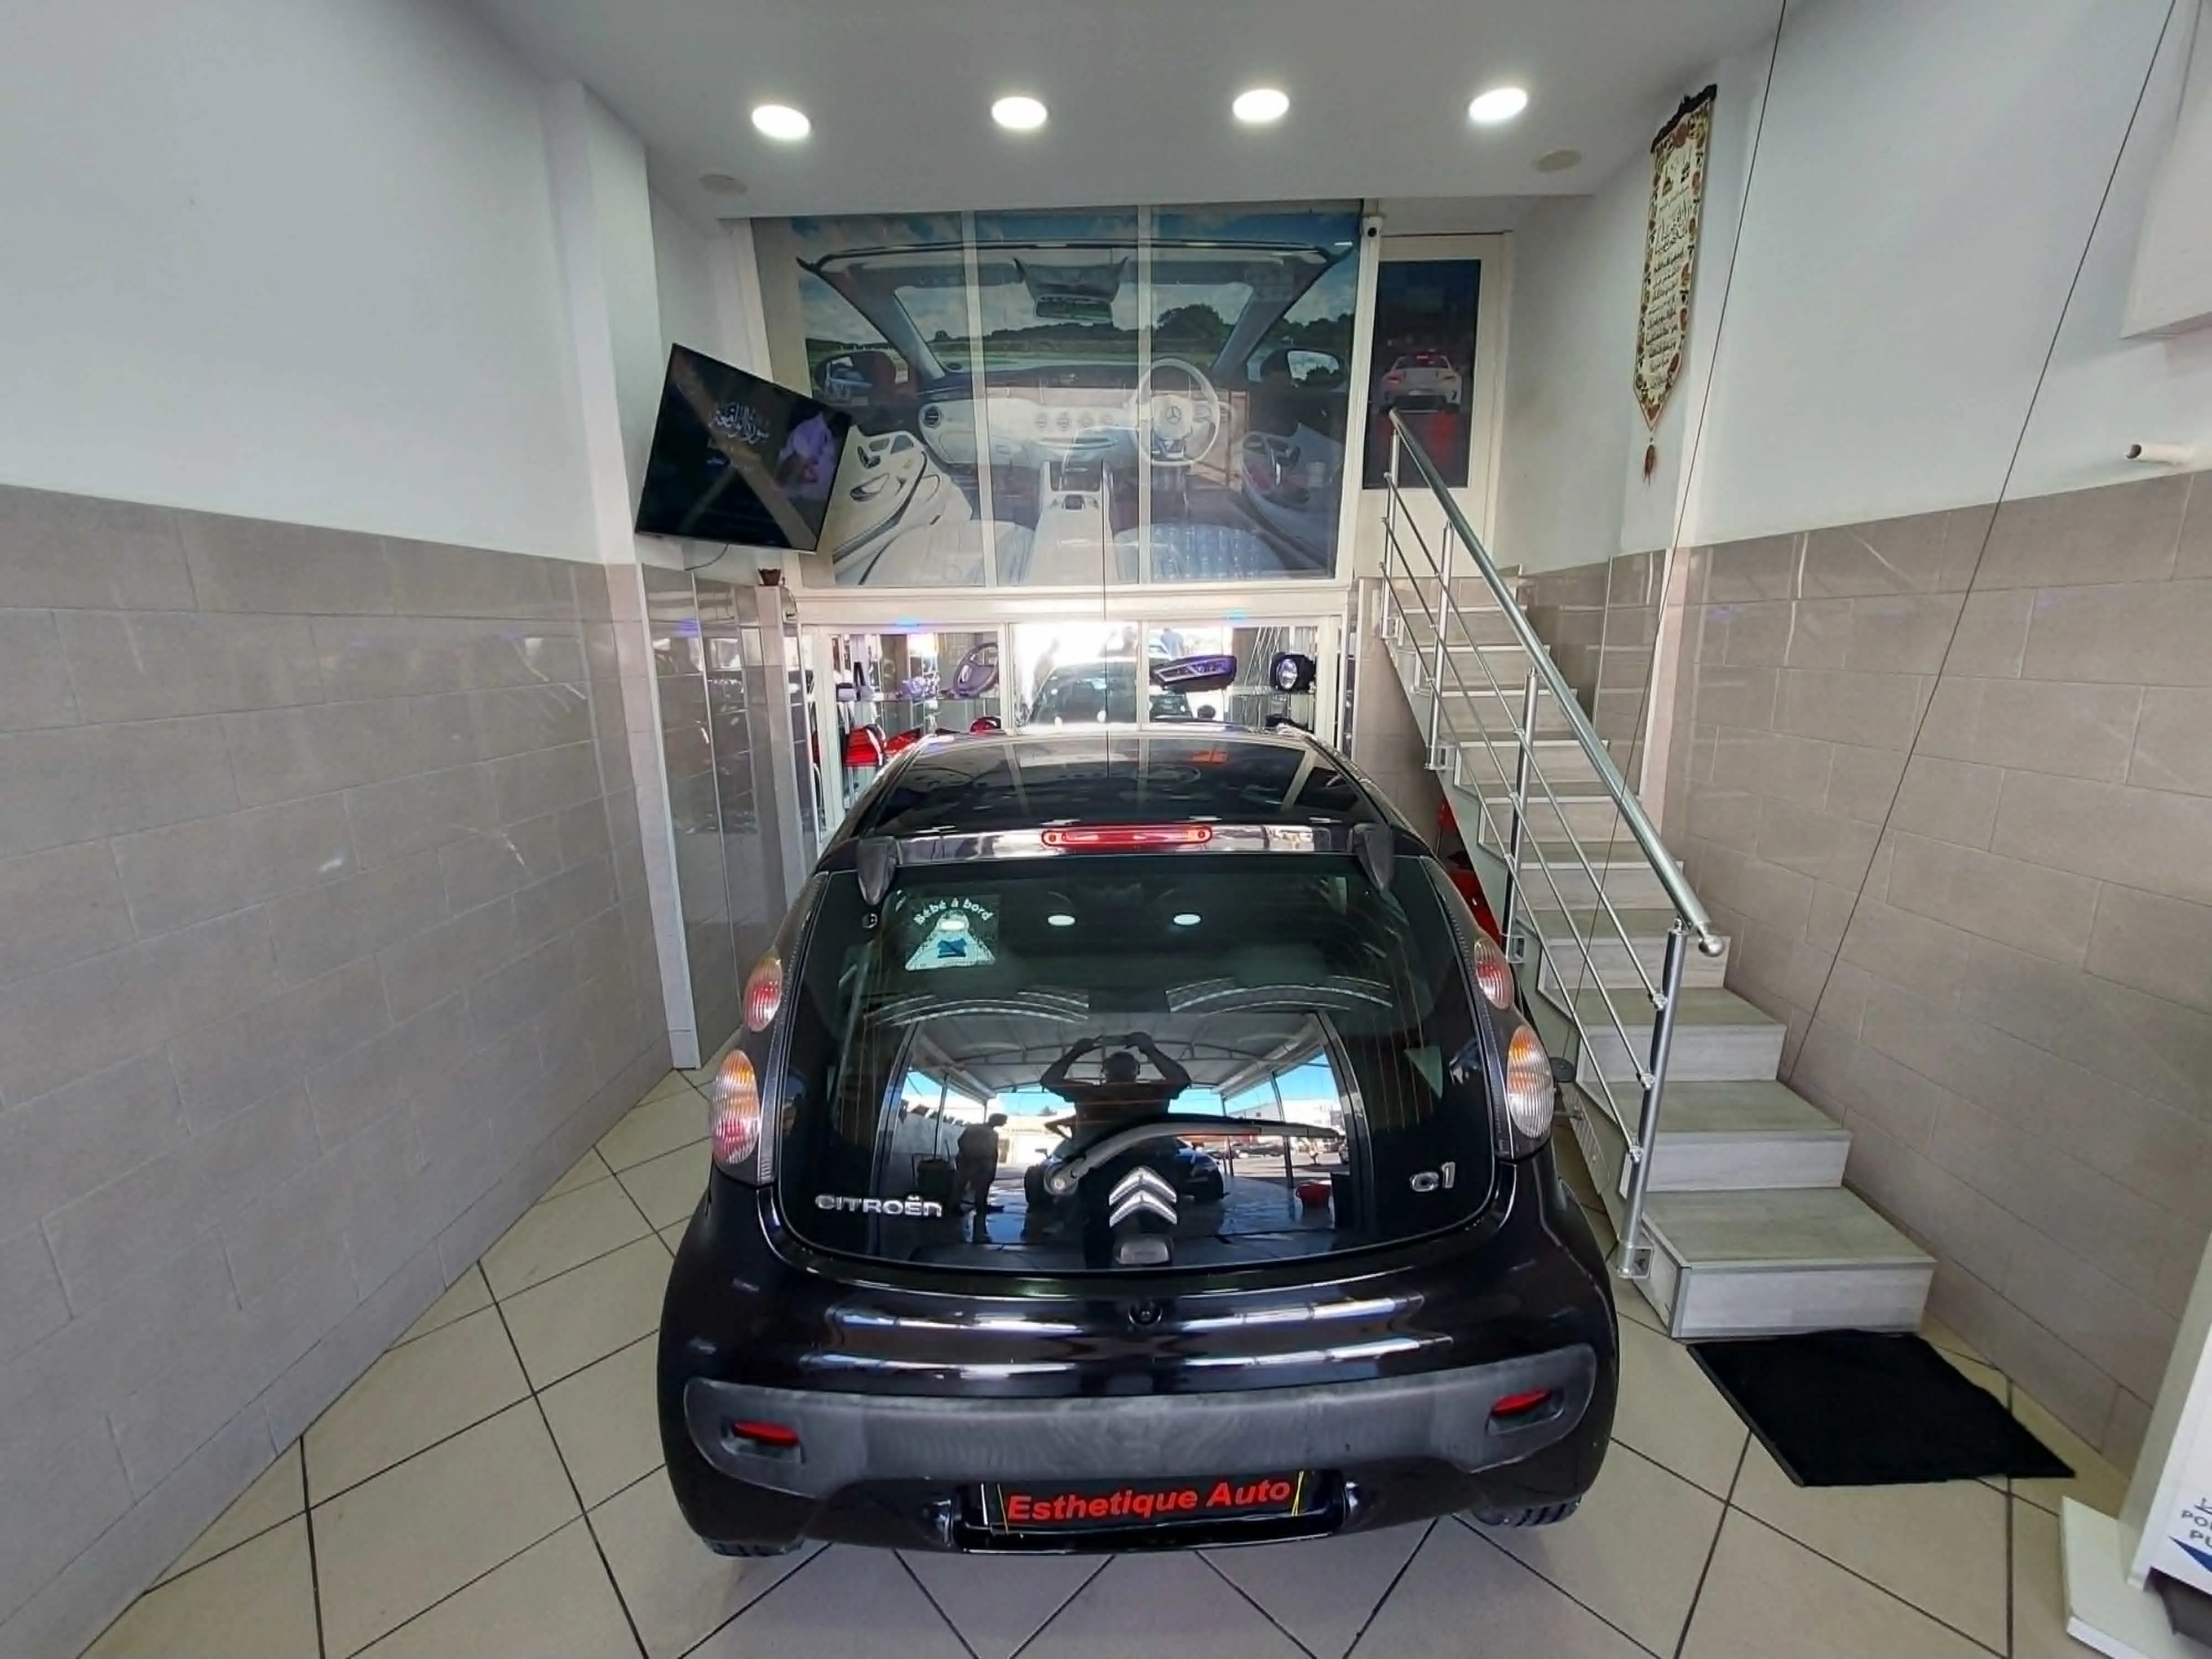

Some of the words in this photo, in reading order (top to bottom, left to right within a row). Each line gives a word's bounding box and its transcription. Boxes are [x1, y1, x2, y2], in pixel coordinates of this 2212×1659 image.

[1410, 1161, 1455, 1192] C1
[1006, 1489, 1198, 1520] Esthetique
[1206, 1480, 1291, 1506] Auto
[2181, 1509, 2212, 1531] PO
